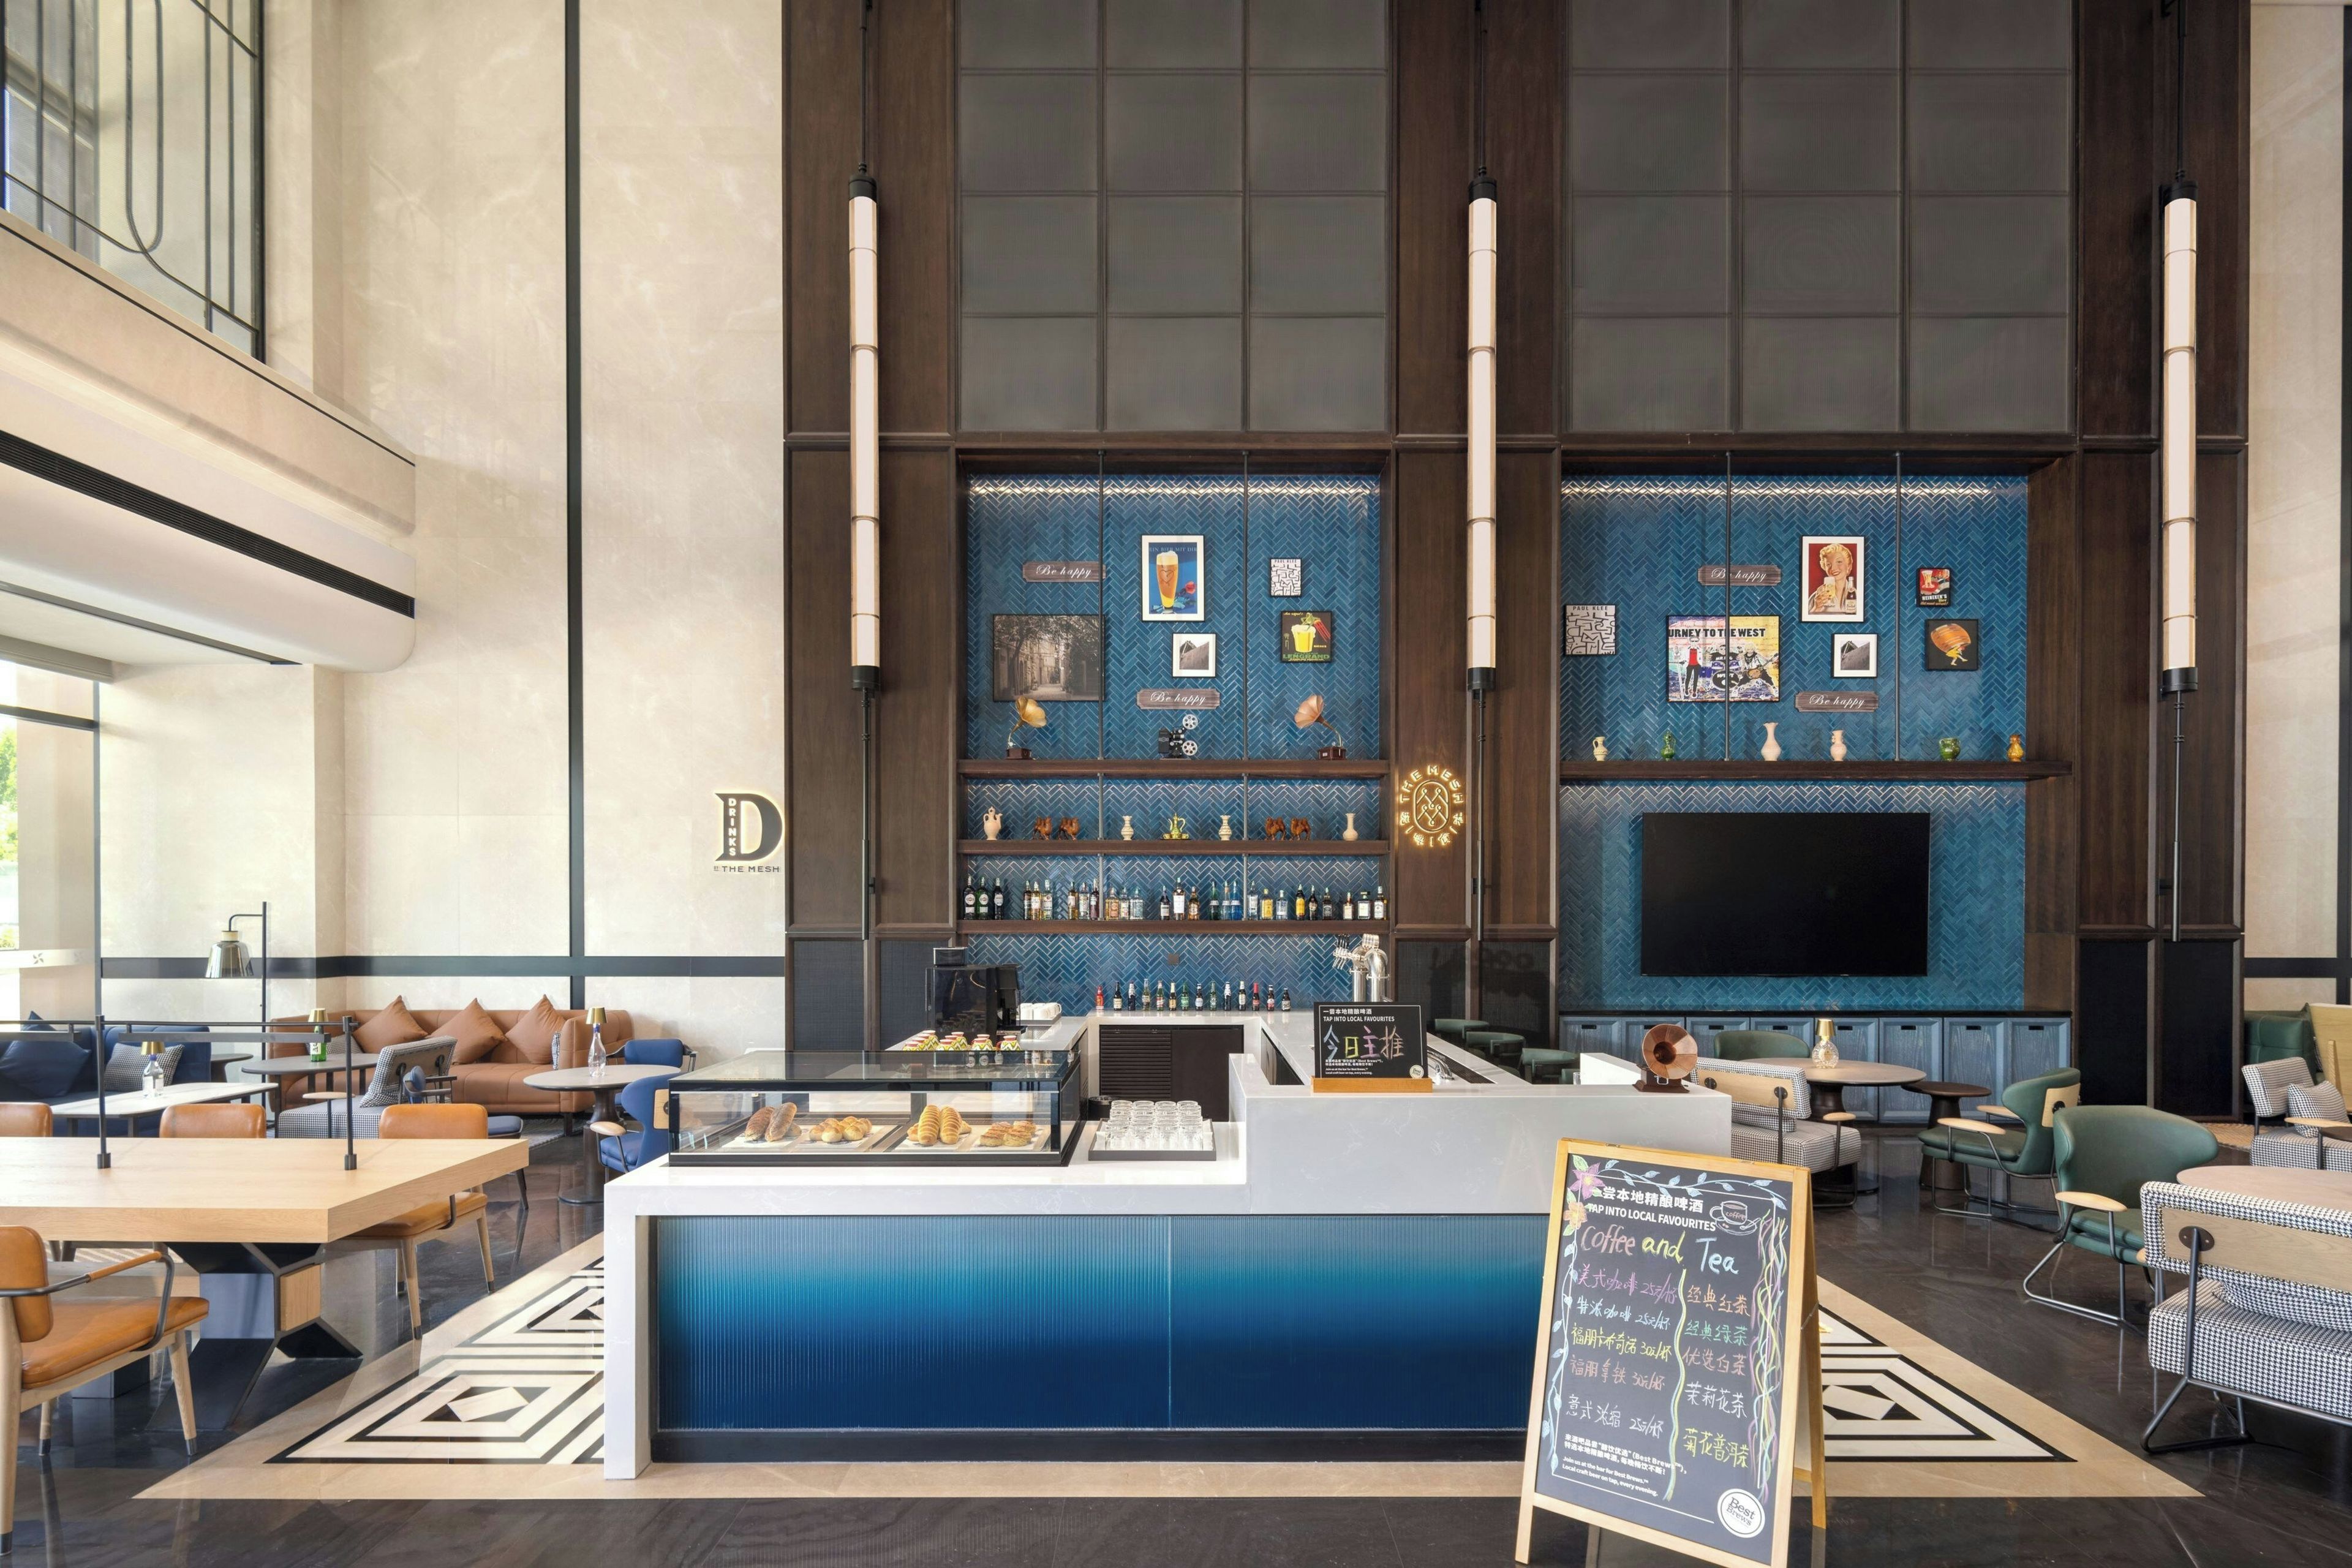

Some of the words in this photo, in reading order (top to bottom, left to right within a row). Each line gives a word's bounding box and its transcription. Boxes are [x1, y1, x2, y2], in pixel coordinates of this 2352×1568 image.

[1036, 564, 1057, 576] Be
[1060, 567, 1092, 578] happy
[1735, 569, 1767, 582] happy
[1703, 628, 1716, 637] TO
[1738, 628, 1766, 637] WEST
[1150, 692, 1171, 702] Be
[1174, 693, 1206, 706] happy
[1809, 694, 1830, 705] Be
[1833, 696, 1864, 709] happy
[1400, 769, 1422, 803] THE
[1427, 764, 1464, 804] MESH
[728, 797, 737, 856] DRINKS
[1323, 1024, 1405, 1060] 今日主推
[1588, 1203, 1604, 1213] TAP
[1605, 1207, 1627, 1218] INTO
[1628, 1209, 1657, 1223] LOCAL
[1658, 1214, 1716, 1232] FAVOURITES
[1580, 1224, 1635, 1256] Coffee
[1642, 1230, 1686, 1264] and
[1695, 1237, 1740, 1275] Tea
[1578, 1263, 1638, 1296] 美式咖啡
[1687, 1283, 1751, 1317] 经典红茶
[1684, 1319, 1749, 1346] 经典绿茶
[1569, 1354, 1626, 1384] 福朋拿铁
[1566, 1393, 1621, 1428] 意式浓缩
[1684, 1381, 1747, 1419] 茉莉花茶
[1683, 1427, 1750, 1468] 菊花普洱茶
[1562, 1455, 1574, 1464] Join
[1614, 1470, 1626, 1479] Best
[1577, 1467, 1588, 1476] craft
[1589, 1471, 1600, 1479] beer
[1608, 1476, 1619, 1486] tap,
[1619, 1481, 1635, 1490] every
[1635, 1485, 1658, 1498] evening.
[1726, 1505, 1752, 1526] Brews
[1728, 1496, 1755, 1520] Best
